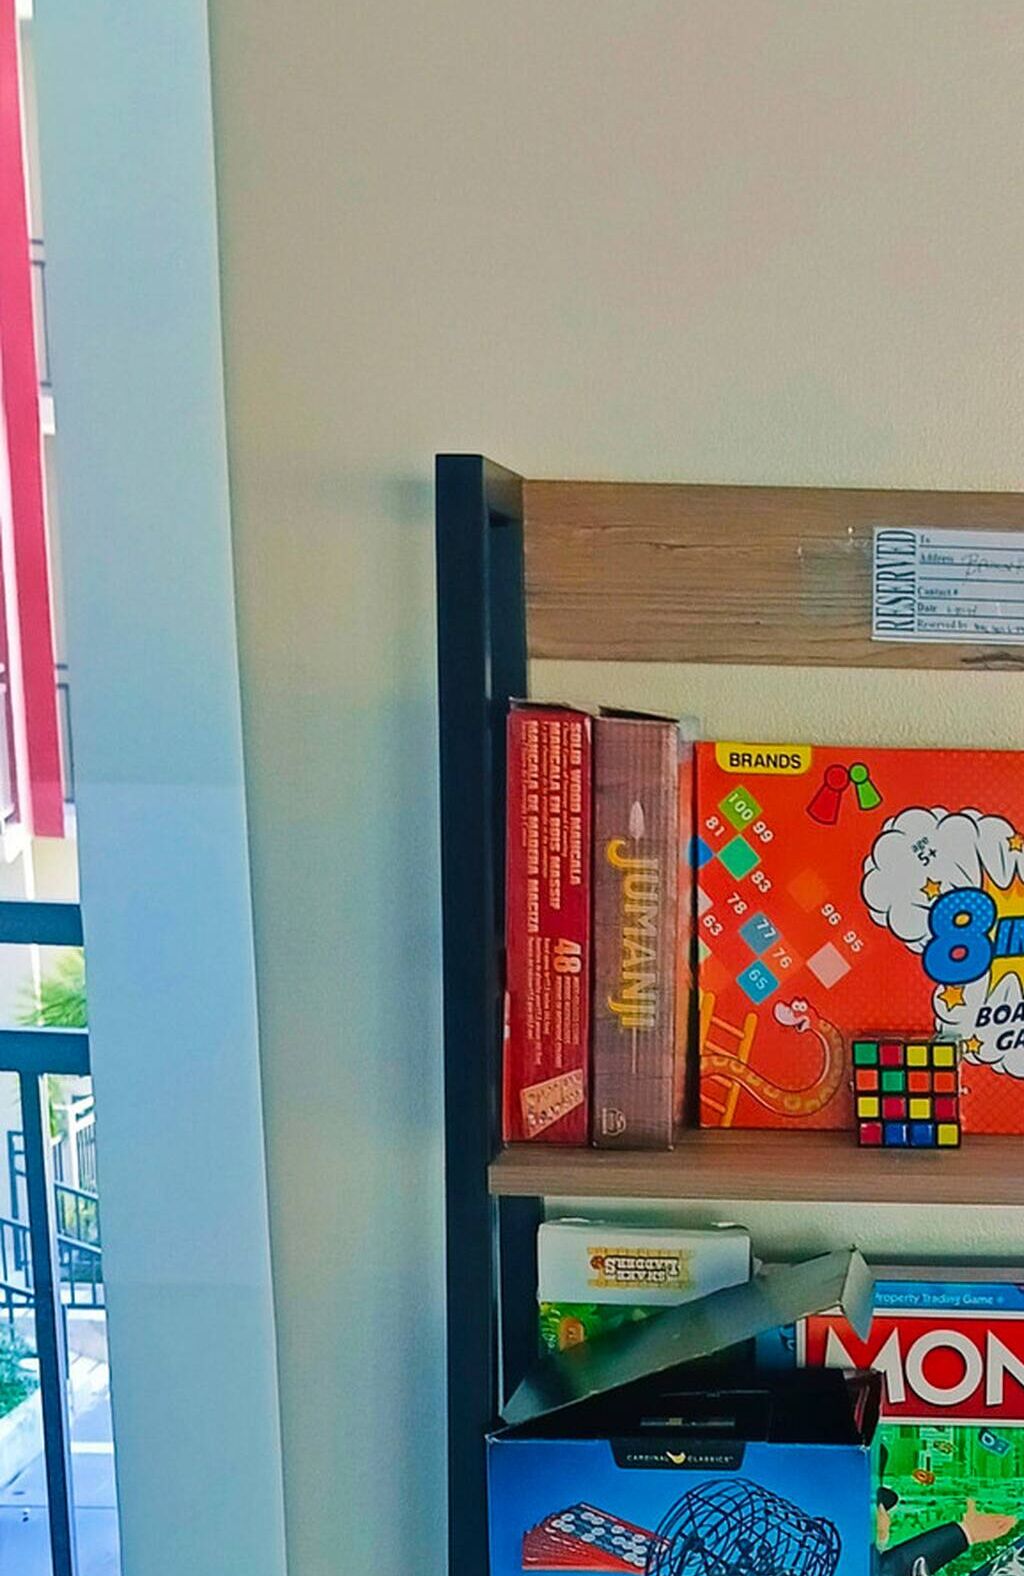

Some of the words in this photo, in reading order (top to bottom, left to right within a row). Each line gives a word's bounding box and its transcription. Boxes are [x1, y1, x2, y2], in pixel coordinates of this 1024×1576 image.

[876, 530, 917, 632] RESERVED
[917, 603, 937, 613] Date
[527, 719, 540, 790] MANCALA
[569, 721, 582, 765] SOLID
[548, 721, 561, 791] MANCALA
[729, 753, 802, 770] BRANDS
[569, 768, 582, 813] WOOD
[548, 795, 561, 814] EN
[727, 792, 753, 822] 100
[548, 817, 561, 852] BOIS
[704, 815, 725, 838] 81
[751, 820, 775, 845] 99
[527, 815, 540, 875] MADERA
[568, 816, 582, 886] MANCALA
[917, 846, 939, 868] 5+
[547, 855, 561, 910] MASSIF
[750, 869, 773, 894] 83
[527, 878, 540, 934] MACIZA
[726, 891, 749, 915] 78
[820, 903, 842, 927] 96
[606, 838, 659, 1032] JUMANJI
[701, 914, 724, 937] 63
[753, 917, 777, 941] 77
[922, 886, 998, 985] 8
[842, 930, 865, 953] 95
[553, 938, 583, 974] 48
[770, 946, 793, 969] 76
[748, 968, 769, 991] 65
[921, 1293, 961, 1306] Trading
[962, 1294, 993, 1305] Game
